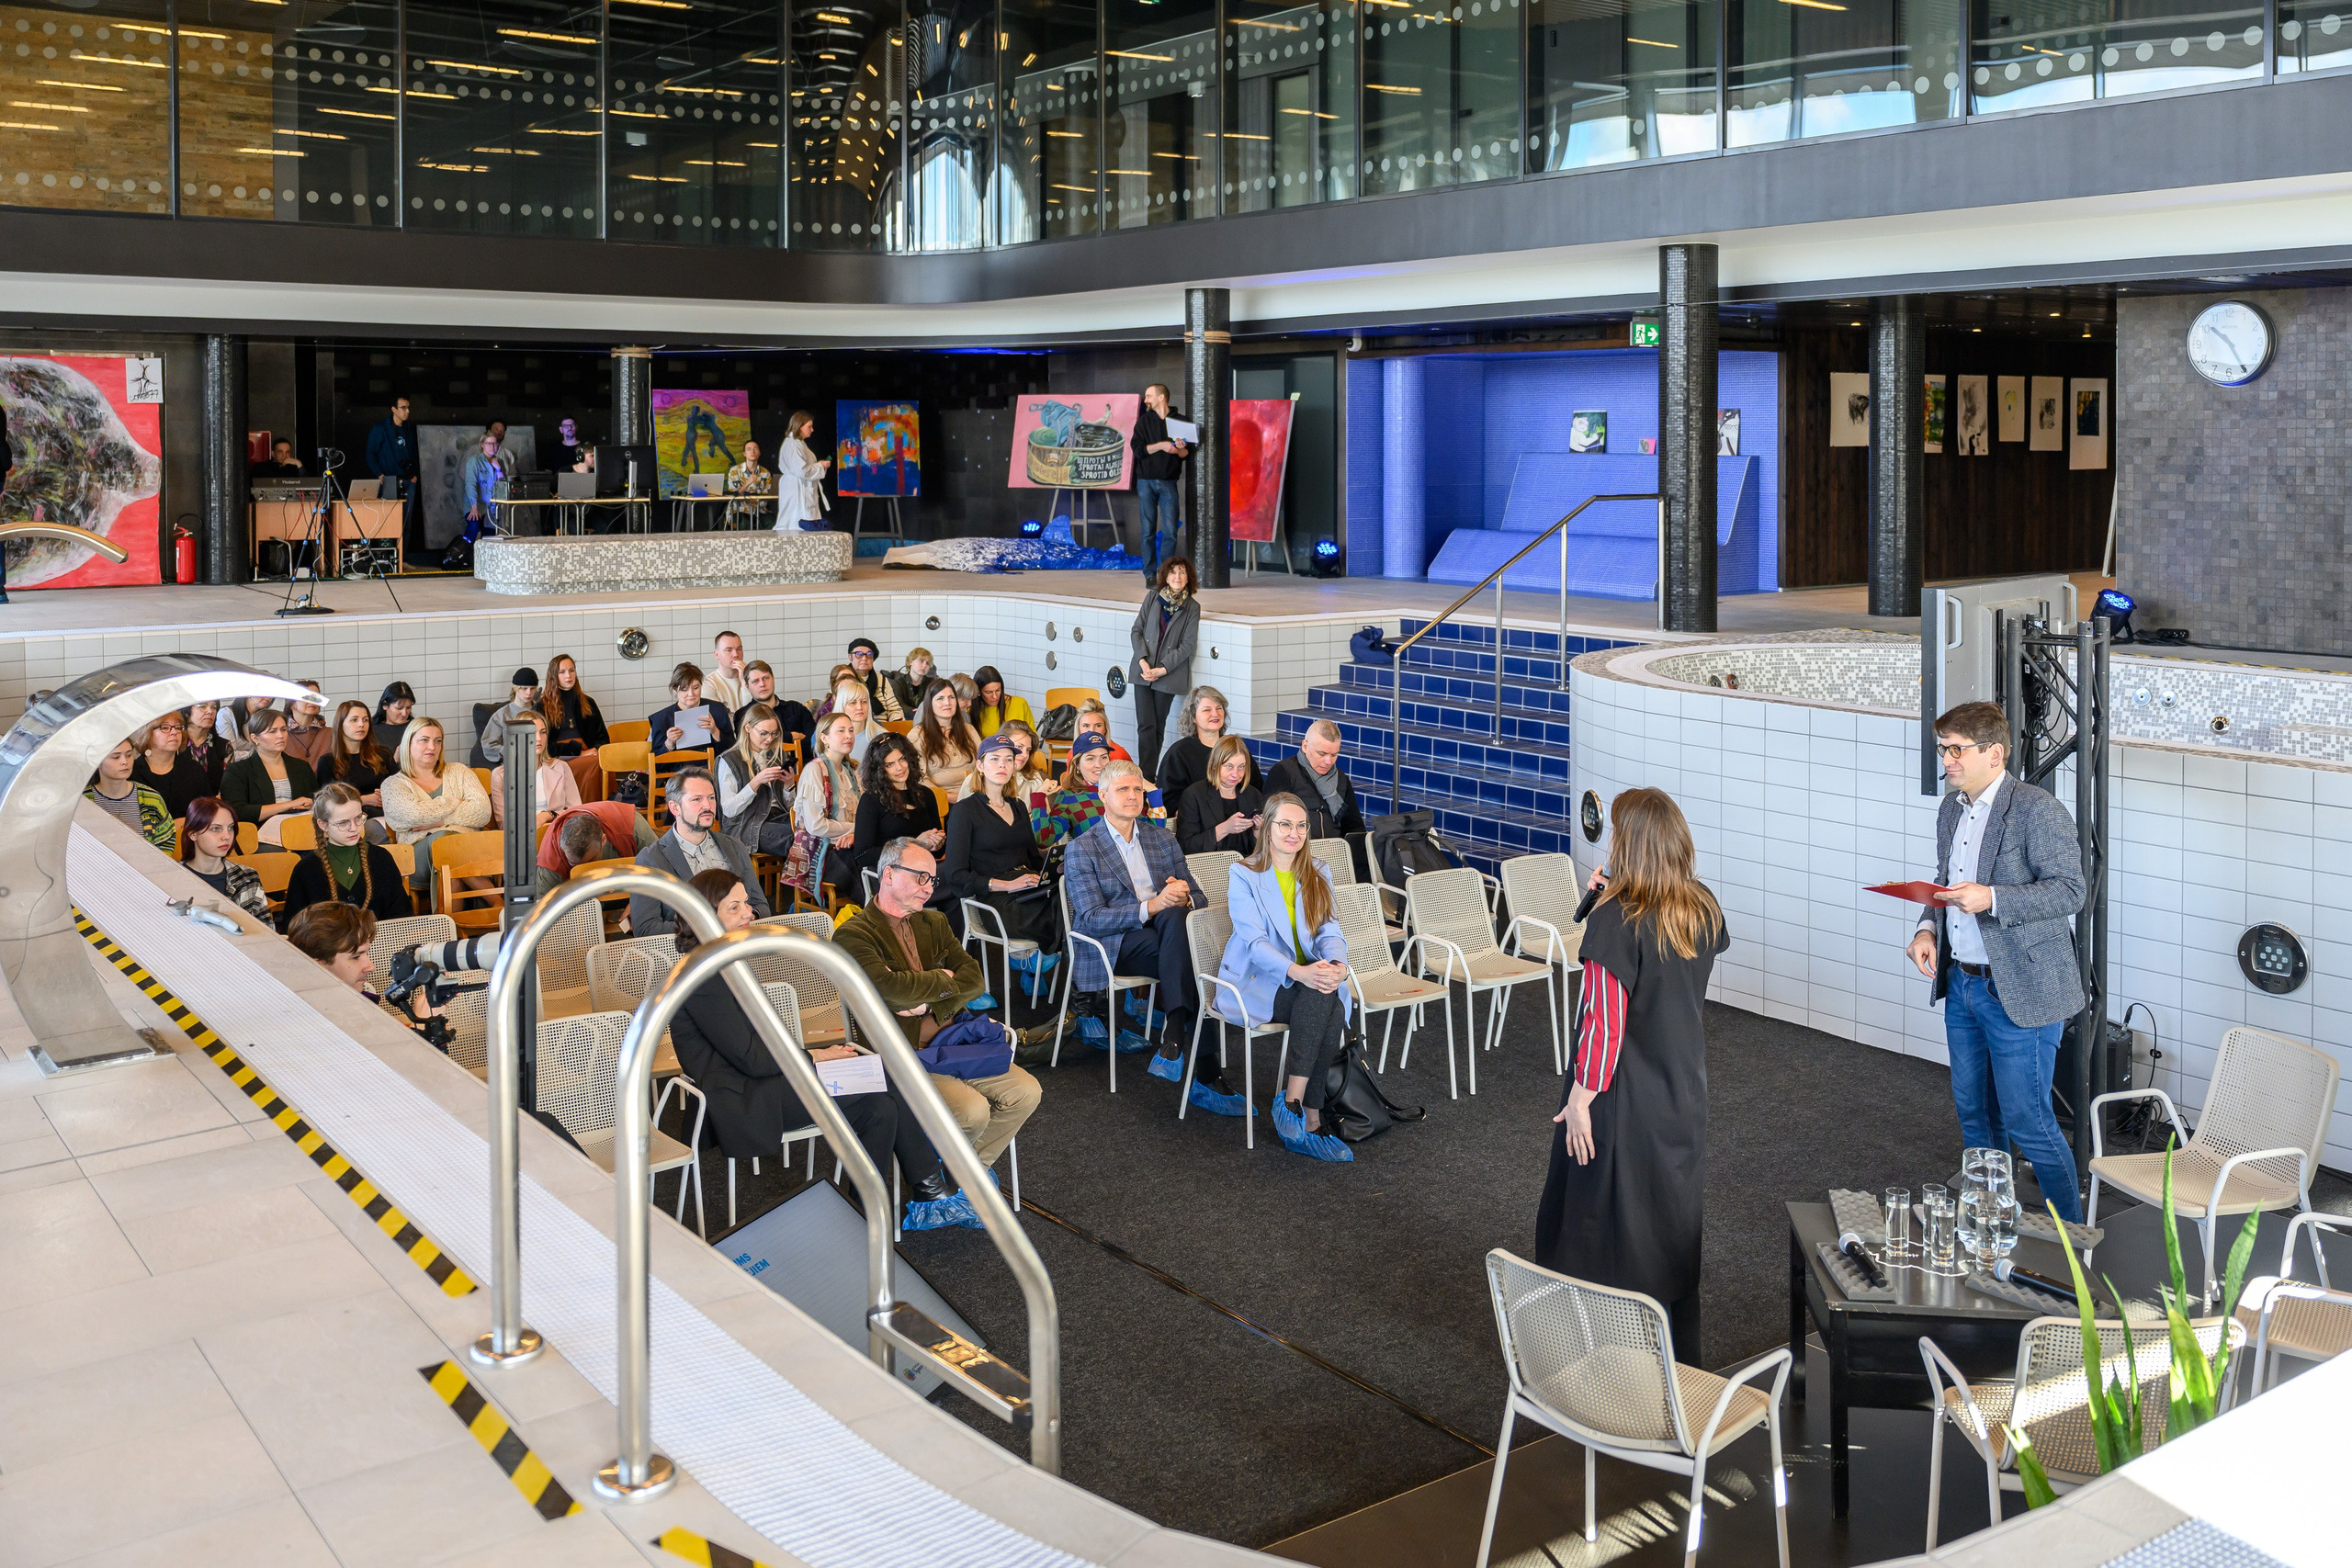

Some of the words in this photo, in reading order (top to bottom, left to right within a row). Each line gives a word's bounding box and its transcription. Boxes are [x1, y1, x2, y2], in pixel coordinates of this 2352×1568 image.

[2211, 313, 2219, 322] 11
[2224, 308, 2234, 318] 12
[2200, 324, 2211, 333] 10
[2252, 321, 2259, 332] 2
[2195, 339, 2202, 349] 9
[2256, 337, 2265, 347] 3
[2200, 354, 2208, 364] 8
[2251, 353, 2258, 362] 4
[2211, 365, 2218, 374] 7
[2225, 367, 2233, 378] 6
[1080, 470, 1108, 479] SPROTID
